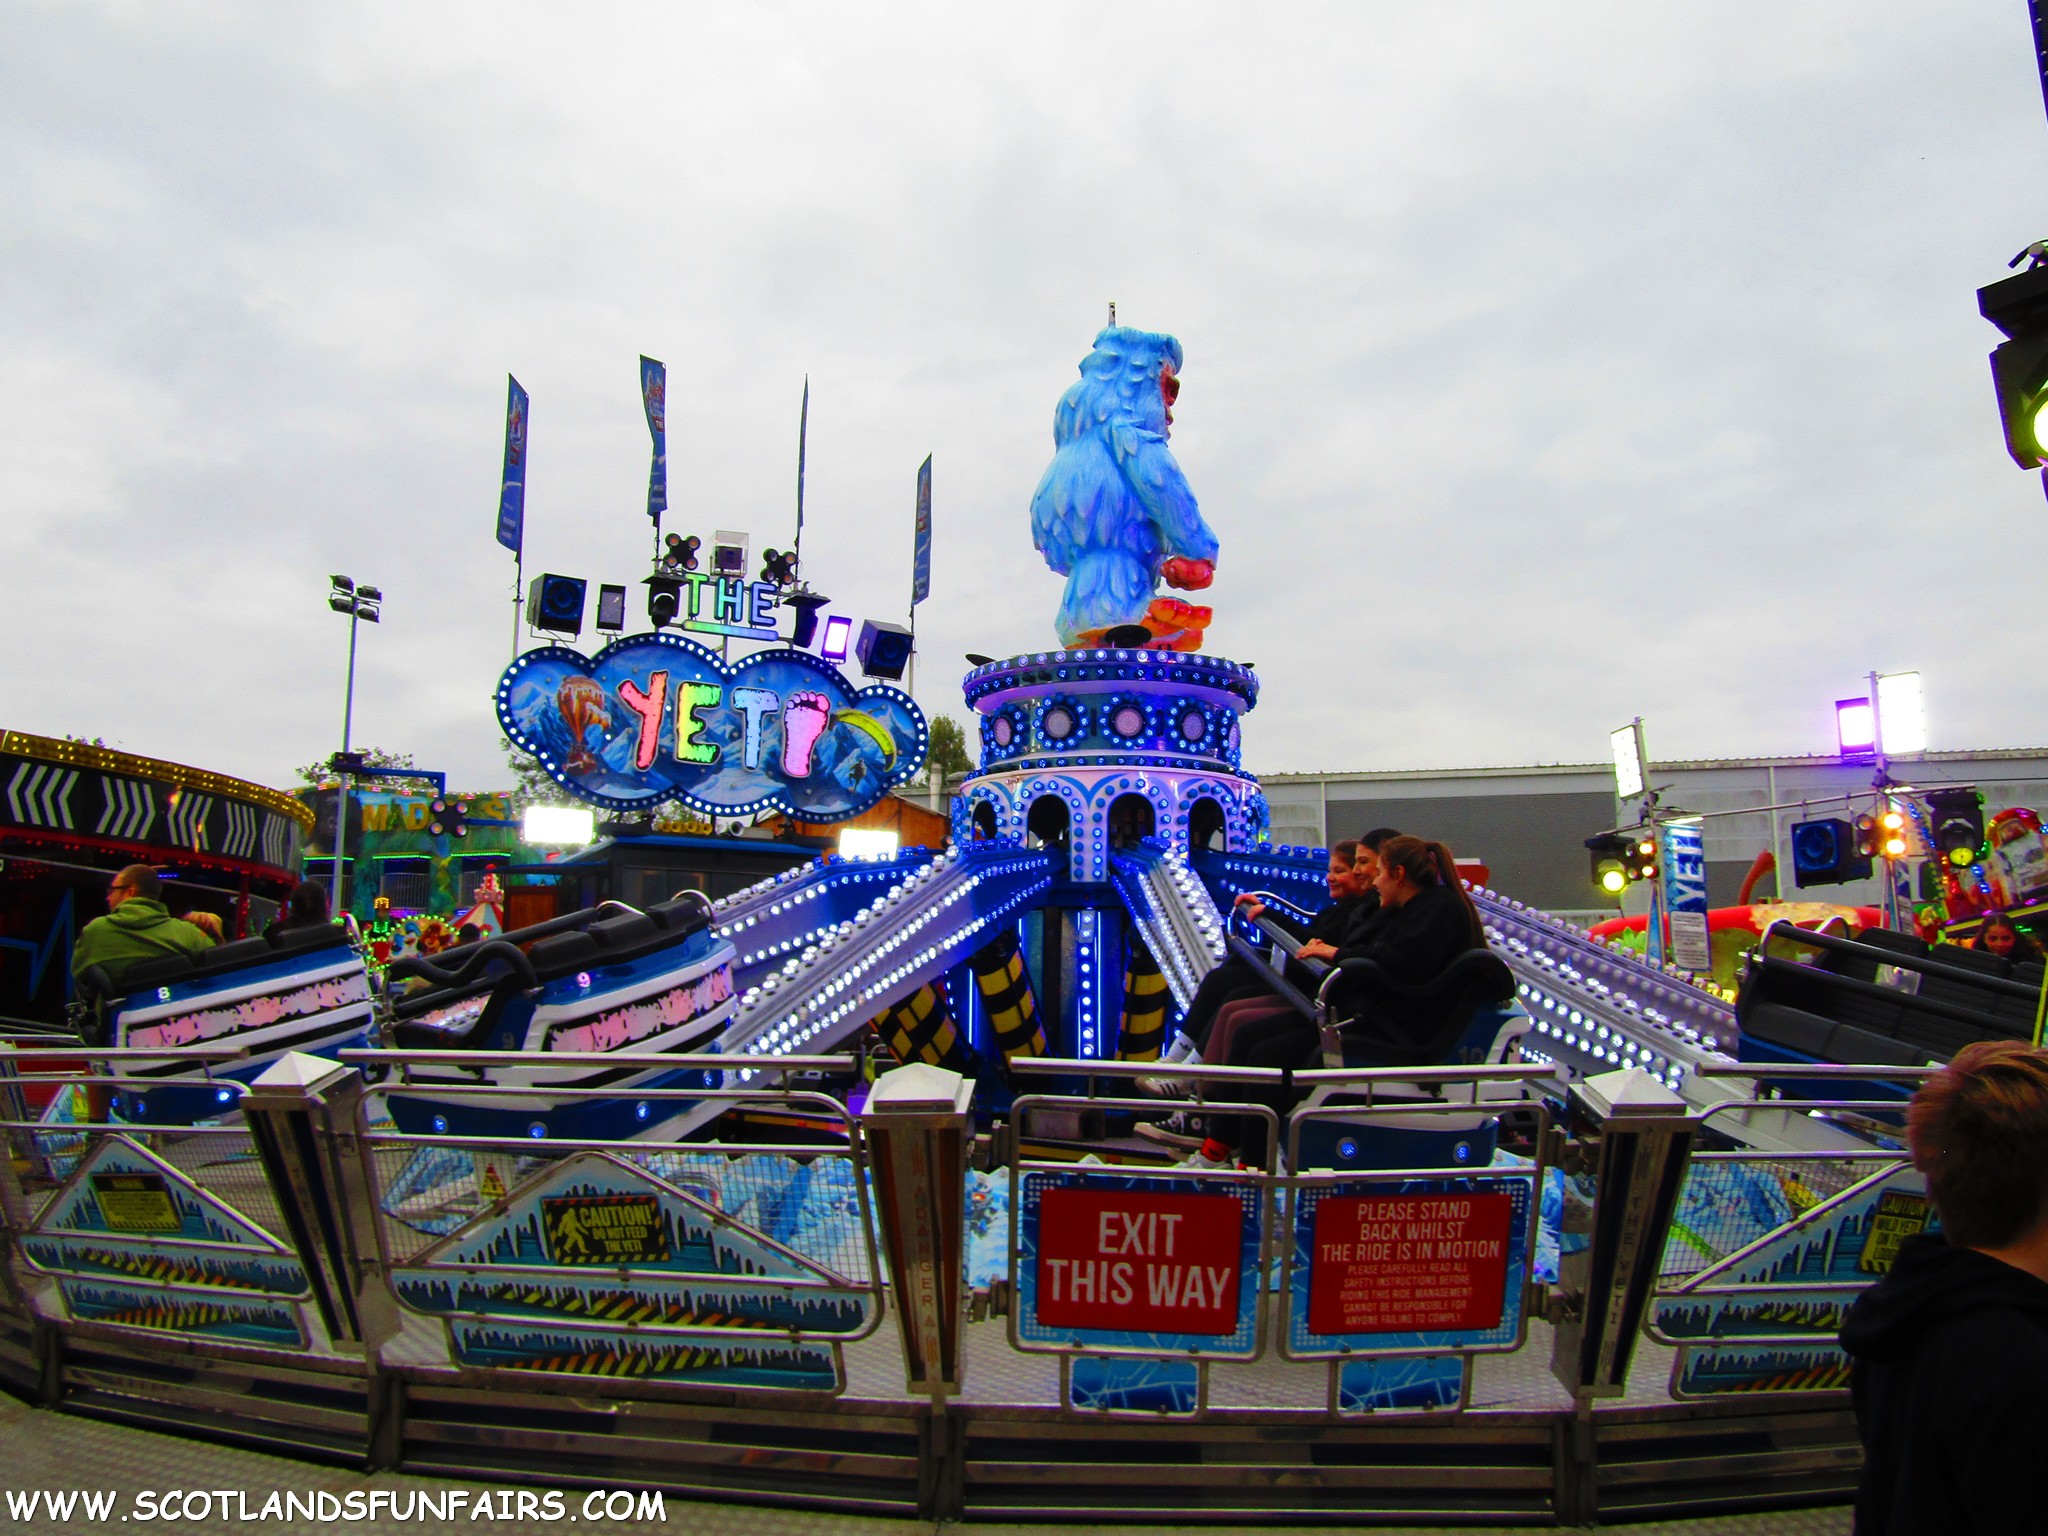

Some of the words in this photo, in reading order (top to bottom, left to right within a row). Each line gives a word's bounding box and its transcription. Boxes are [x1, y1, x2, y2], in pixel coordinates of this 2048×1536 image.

[684, 573, 777, 627] THE
[1670, 827, 1707, 905] YETI
[158, 986, 171, 999] 8
[580, 1204, 653, 1228] CAUTION!
[1357, 1202, 1416, 1221] PLEASE
[1420, 1201, 1471, 1219] STAND
[593, 1228, 606, 1240] DO
[607, 1227, 624, 1239] NOT
[625, 1226, 648, 1239] FEED
[1098, 1211, 1183, 1256] EXIT
[1360, 1222, 1402, 1241] BACK
[1406, 1221, 1465, 1240] WHILST
[604, 1240, 622, 1252] THE
[622, 1240, 643, 1252] YETI
[1322, 1244, 1351, 1262] THE
[1356, 1243, 1392, 1261] RIDE
[1397, 1242, 1411, 1260] IS
[1416, 1241, 1433, 1260] IN
[1437, 1240, 1500, 1259] MOTION
[1348, 1264, 1378, 1275] PLEASE
[1381, 1263, 1427, 1274] CAREFULLY
[1429, 1263, 1451, 1273] READ
[1453, 1262, 1468, 1272] ALL
[1046, 1258, 1134, 1305] THIS
[1147, 1264, 1231, 1309] WAY
[1344, 1278, 1373, 1288] SAFETY
[1376, 1275, 1437, 1287] INSTRUCTIONS
[1439, 1274, 1470, 1285] BEFORE
[1340, 1290, 1369, 1301] RIDING
[1371, 1289, 1390, 1300] THIS
[1414, 1287, 1473, 1298] MANAGEMENT
[1343, 1302, 1377, 1313] CANNOT
[1379, 1302, 1390, 1312] BE
[1392, 1300, 1448, 1311] RESPONSIBLE
[1451, 1299, 1467, 1310] FOR
[1345, 1315, 1378, 1325] ANYONE
[1381, 1313, 1413, 1324] FAILING
[1415, 1313, 1425, 1323] TO
